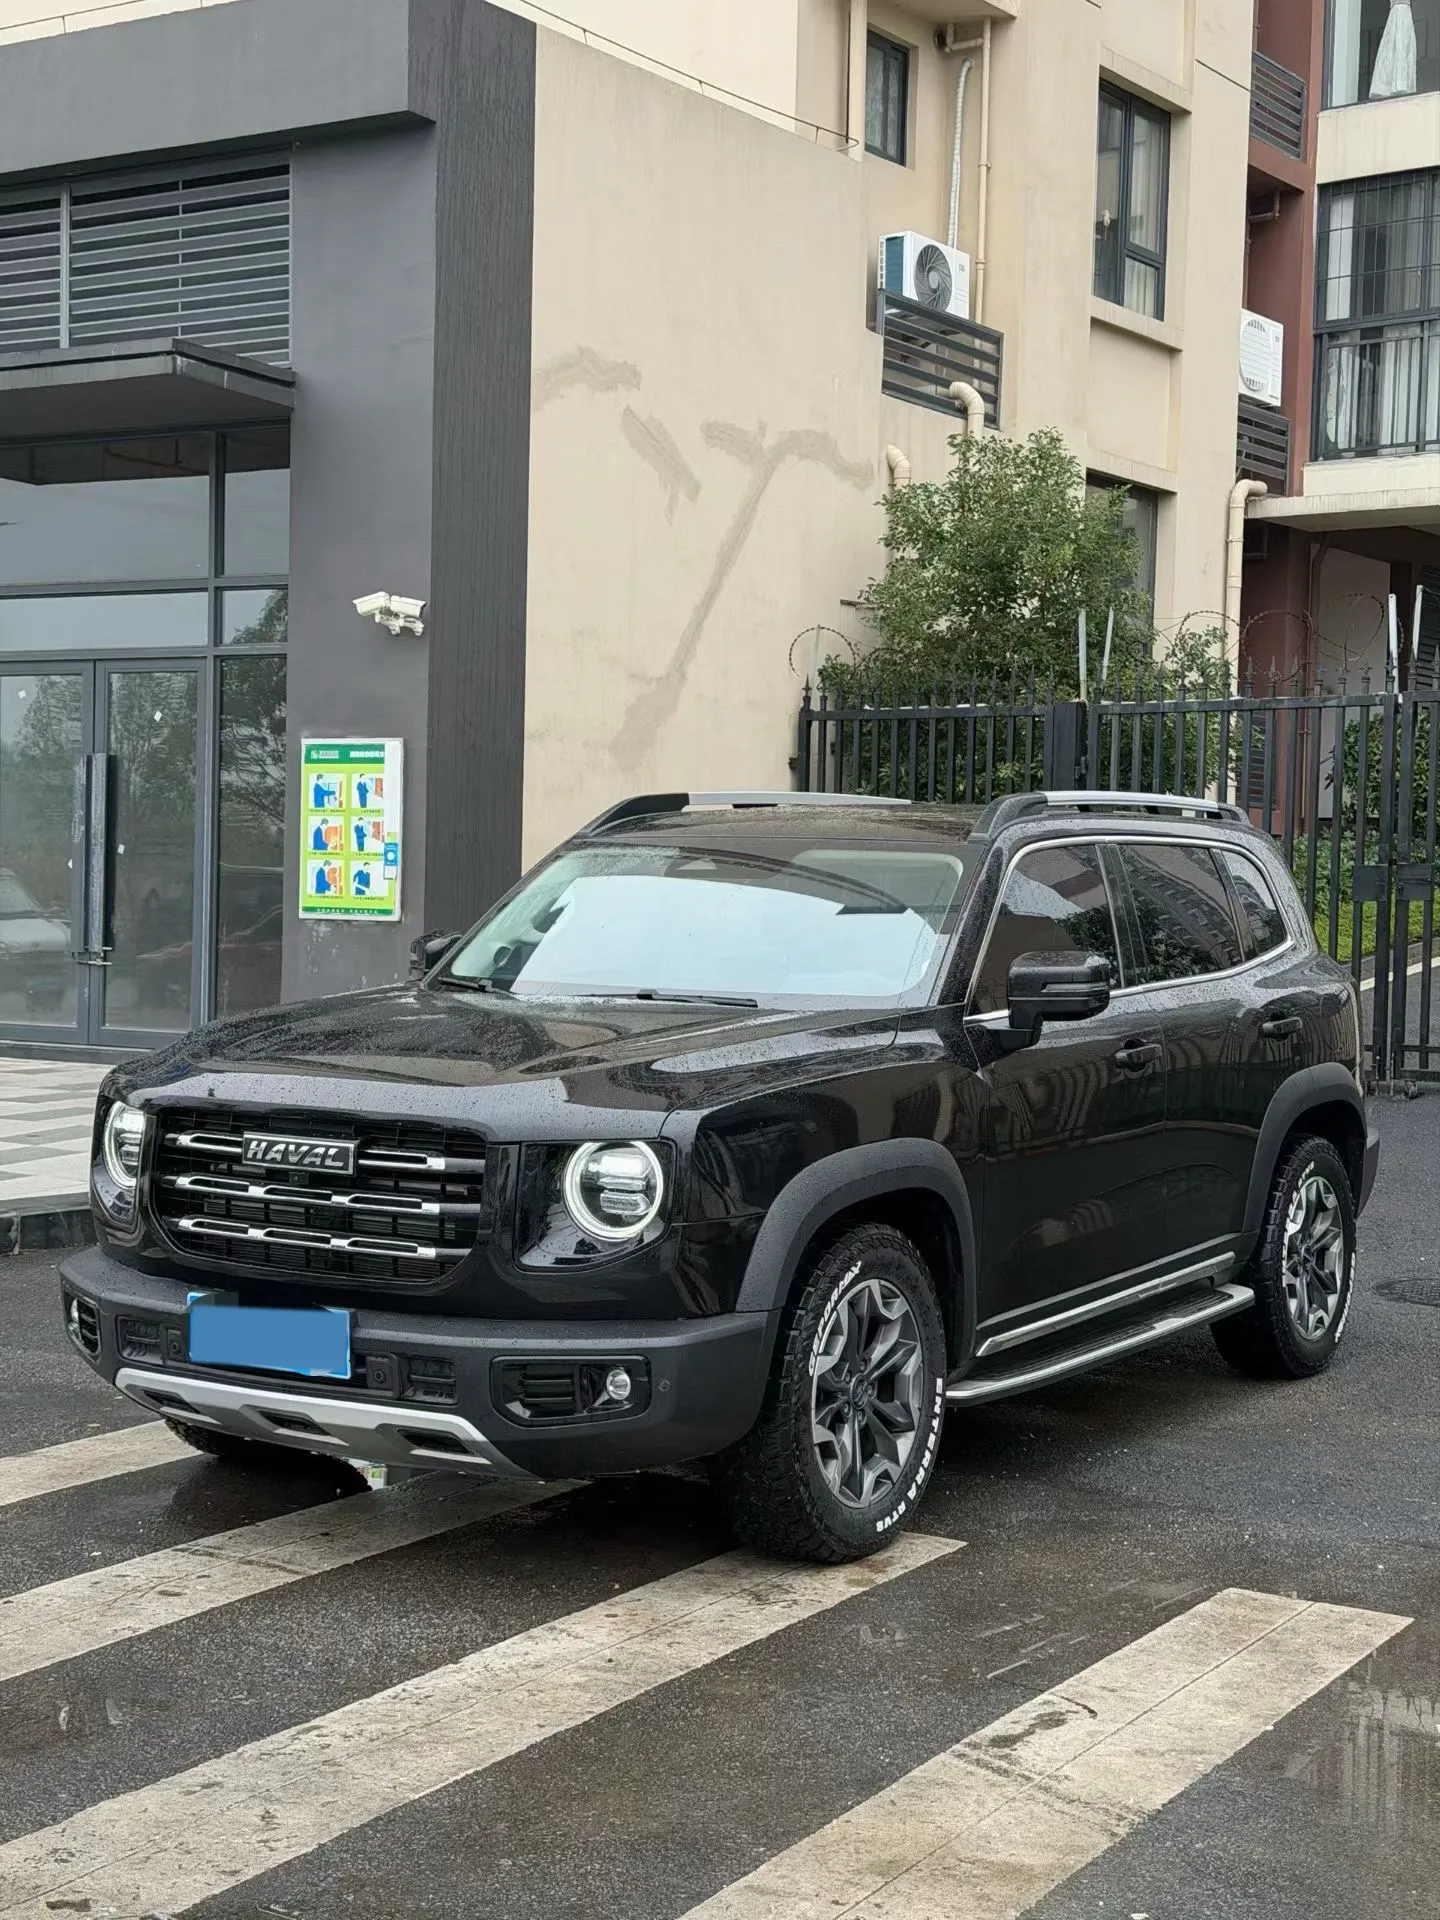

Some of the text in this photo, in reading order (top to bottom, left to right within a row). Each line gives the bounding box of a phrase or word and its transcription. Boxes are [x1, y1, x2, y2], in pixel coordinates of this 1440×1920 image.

[246, 1140, 345, 1168] HAVAL
[876, 1377, 943, 1533] ENTERRA RTV8
